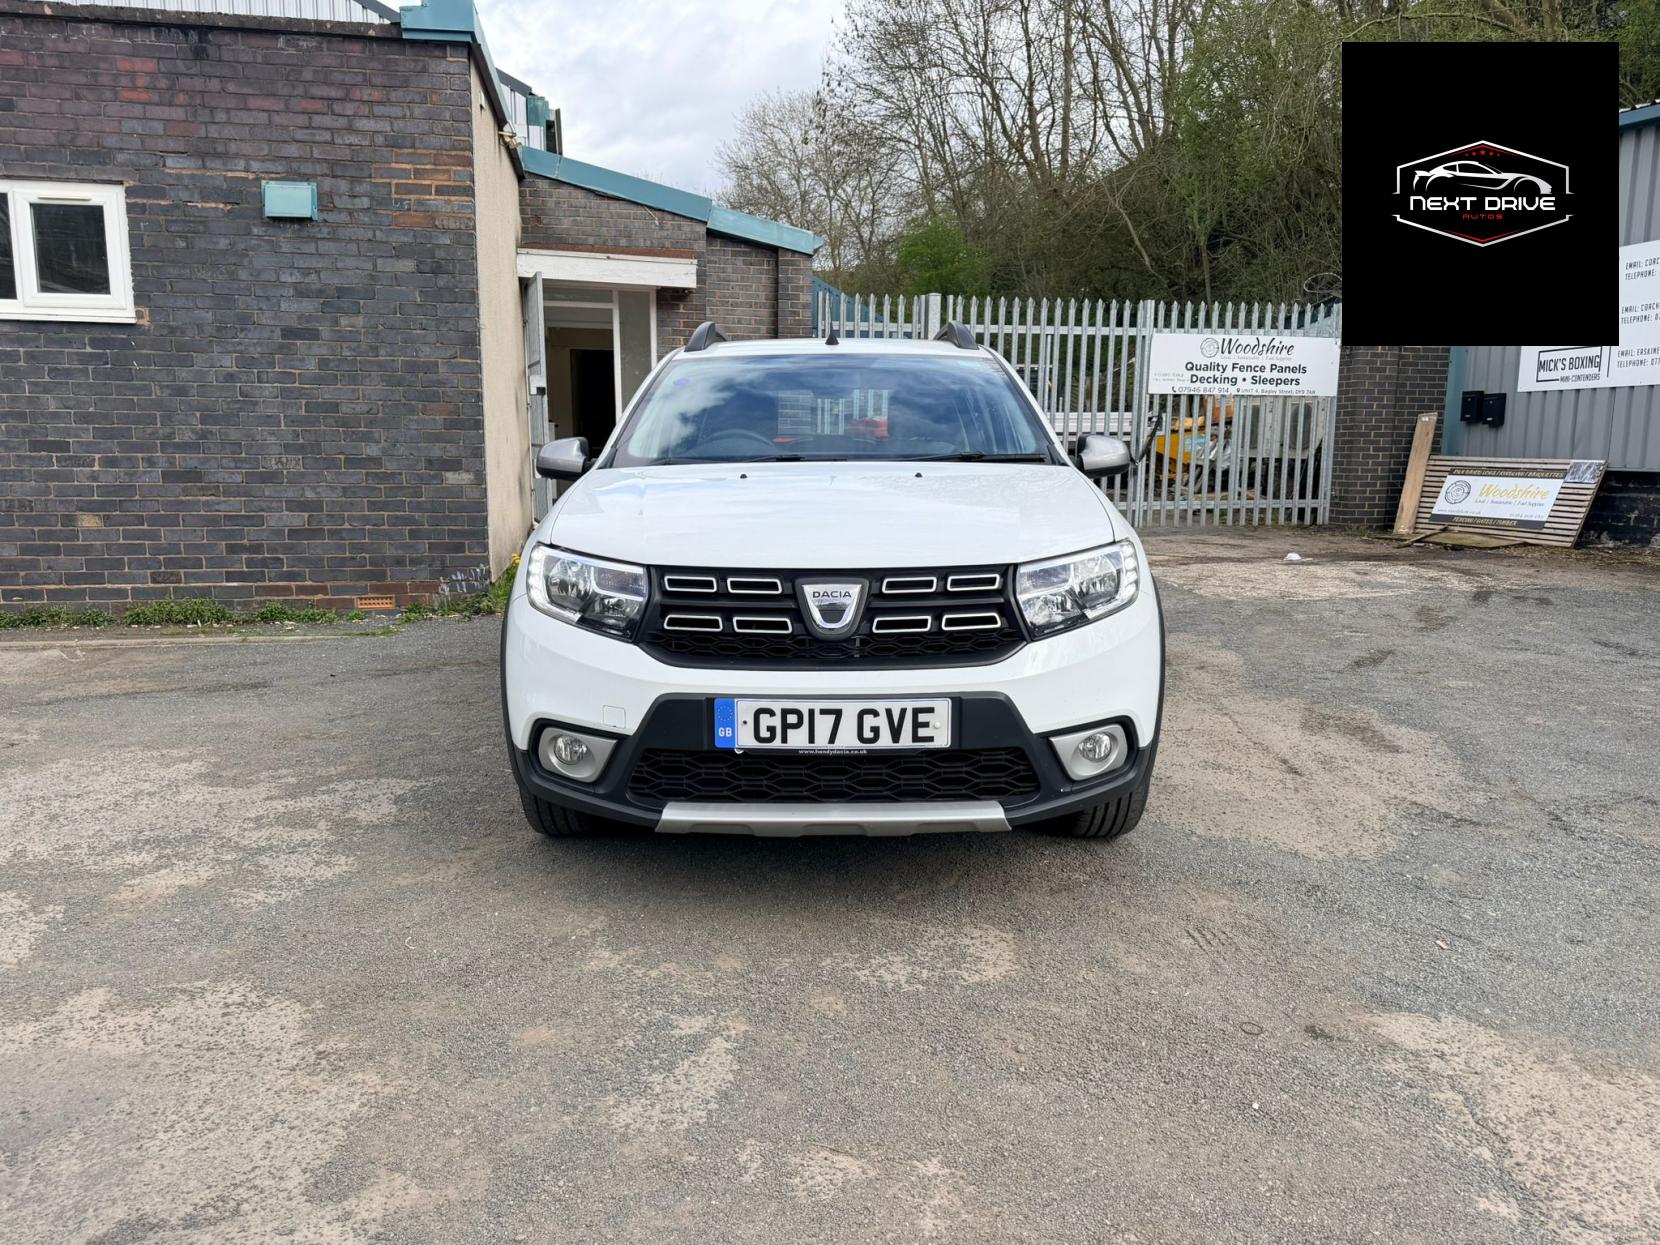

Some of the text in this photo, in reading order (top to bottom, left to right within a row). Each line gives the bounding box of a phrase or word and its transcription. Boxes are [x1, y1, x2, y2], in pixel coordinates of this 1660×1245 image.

[1625, 269, 1657, 281] TELEPHONE:
[1621, 313, 1653, 325] TELEPHONE:
[1220, 337, 1295, 356] Woodshire
[1185, 361, 1307, 374] Quality Fence Panels
[1538, 355, 1600, 373] MICK'S BOXING
[1617, 358, 1649, 369] TELEPHONE:
[1190, 374, 1238, 386] Decking
[1251, 375, 1301, 387] Sleepers
[1478, 483, 1550, 499] Woodshire
[753, 706, 936, 744] GP17 GVE
[718, 727, 733, 737] GB
